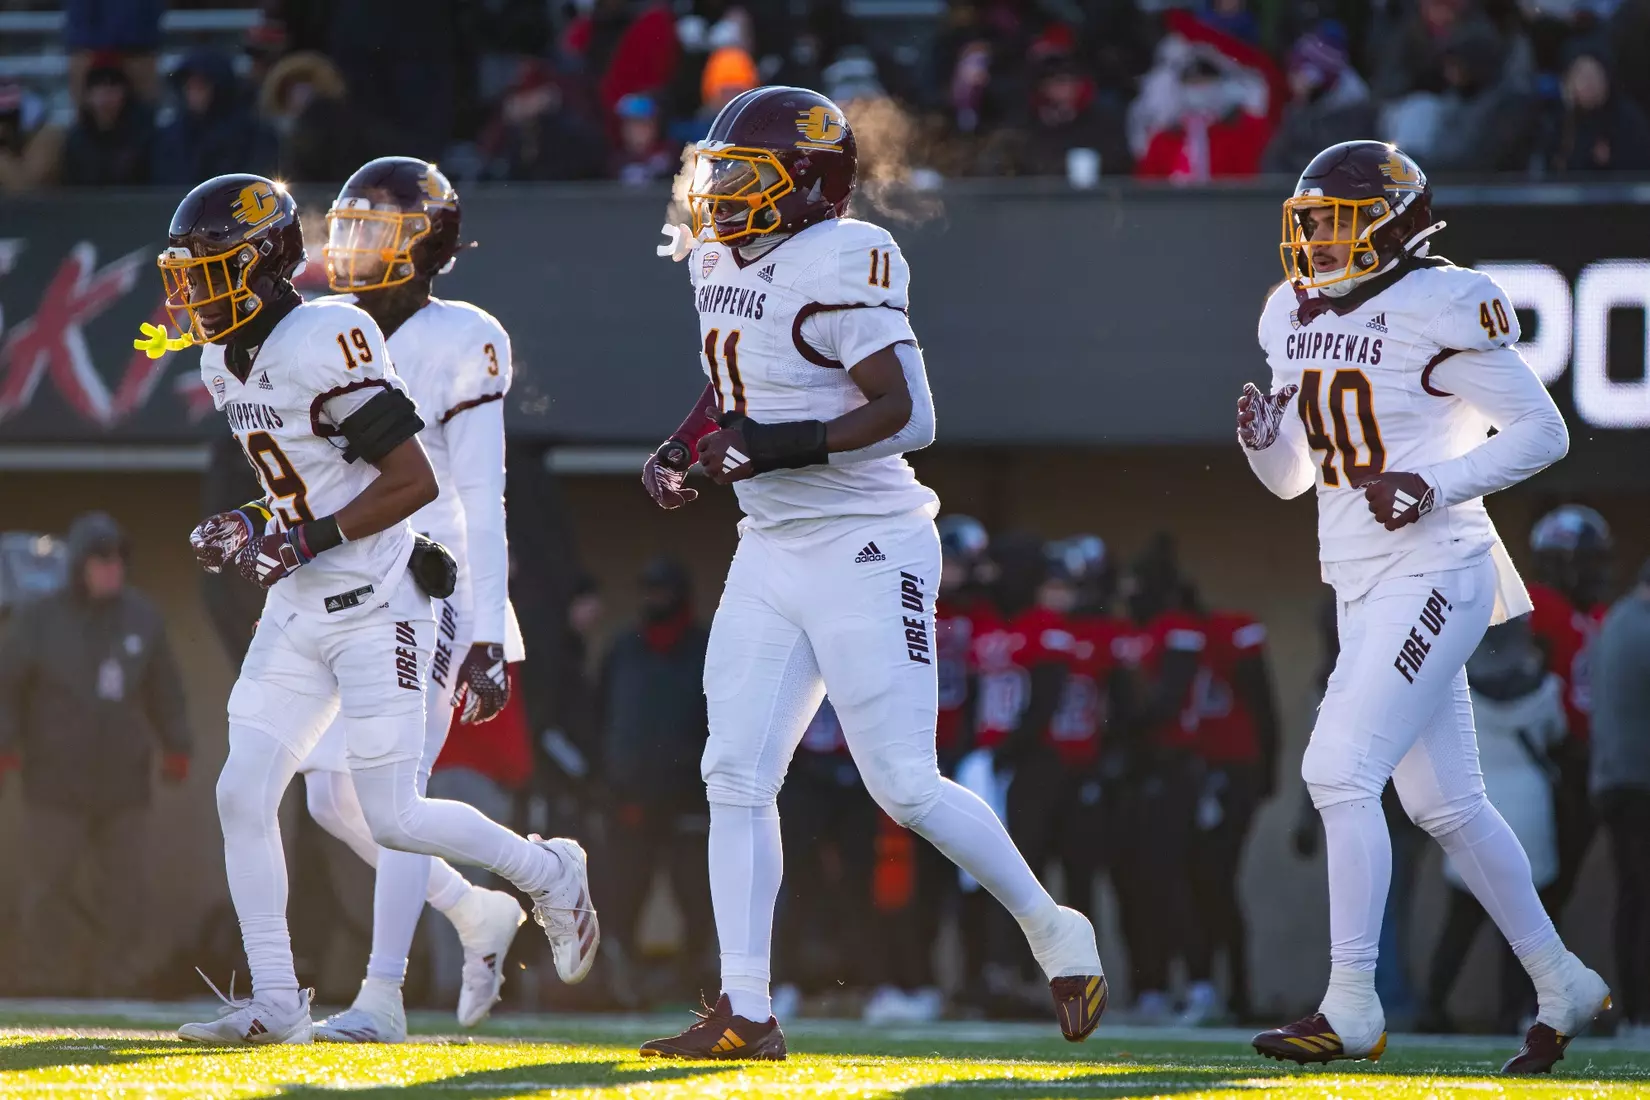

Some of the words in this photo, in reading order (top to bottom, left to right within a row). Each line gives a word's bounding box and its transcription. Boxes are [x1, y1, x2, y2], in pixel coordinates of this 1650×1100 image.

[868, 248, 891, 289] 11
[698, 284, 767, 320] CHIPPEWAS
[1479, 298, 1510, 340] 40
[1365, 321, 1389, 334] adidas
[336, 327, 373, 371] 19
[483, 342, 499, 377] 3
[1286, 332, 1383, 366] CHIPPEWAS
[704, 327, 748, 416] 11
[225, 402, 284, 430] HIPPEWAS
[1298, 368, 1387, 490] 40
[854, 553, 887, 564] adidas
[900, 570, 925, 613] UP!
[902, 615, 931, 665] FIRE
[1393, 626, 1431, 685] FIRE
[1419, 588, 1453, 636] UP!
[395, 646, 422, 691] FIRE
[431, 638, 453, 689] FIRE
